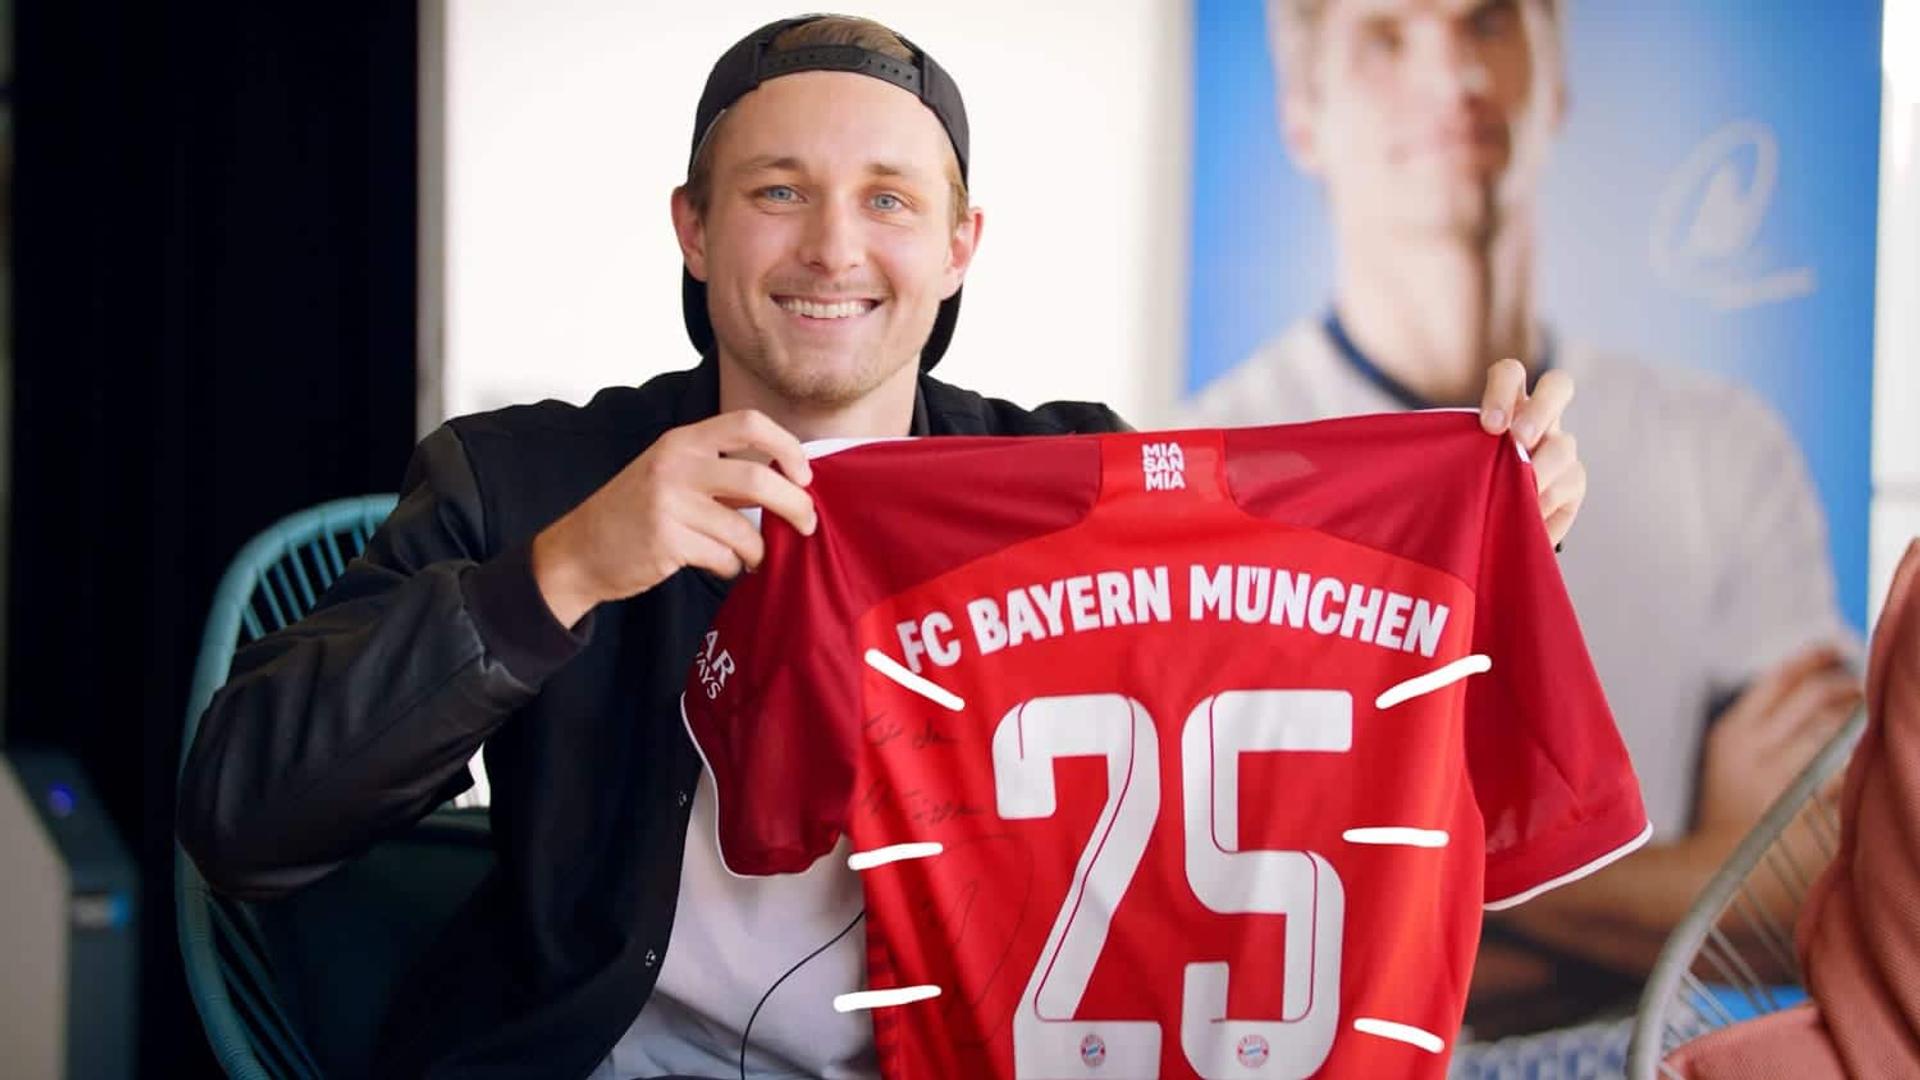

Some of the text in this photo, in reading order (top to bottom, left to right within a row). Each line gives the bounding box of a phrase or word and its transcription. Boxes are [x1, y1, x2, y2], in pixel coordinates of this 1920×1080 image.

[1142, 442, 1183, 459] MIA
[1143, 455, 1185, 474] SAN
[1145, 471, 1187, 492] MIA
[896, 564, 1449, 673] FC BAYERN MÜNCHEN
[992, 690, 1353, 1080] 25
